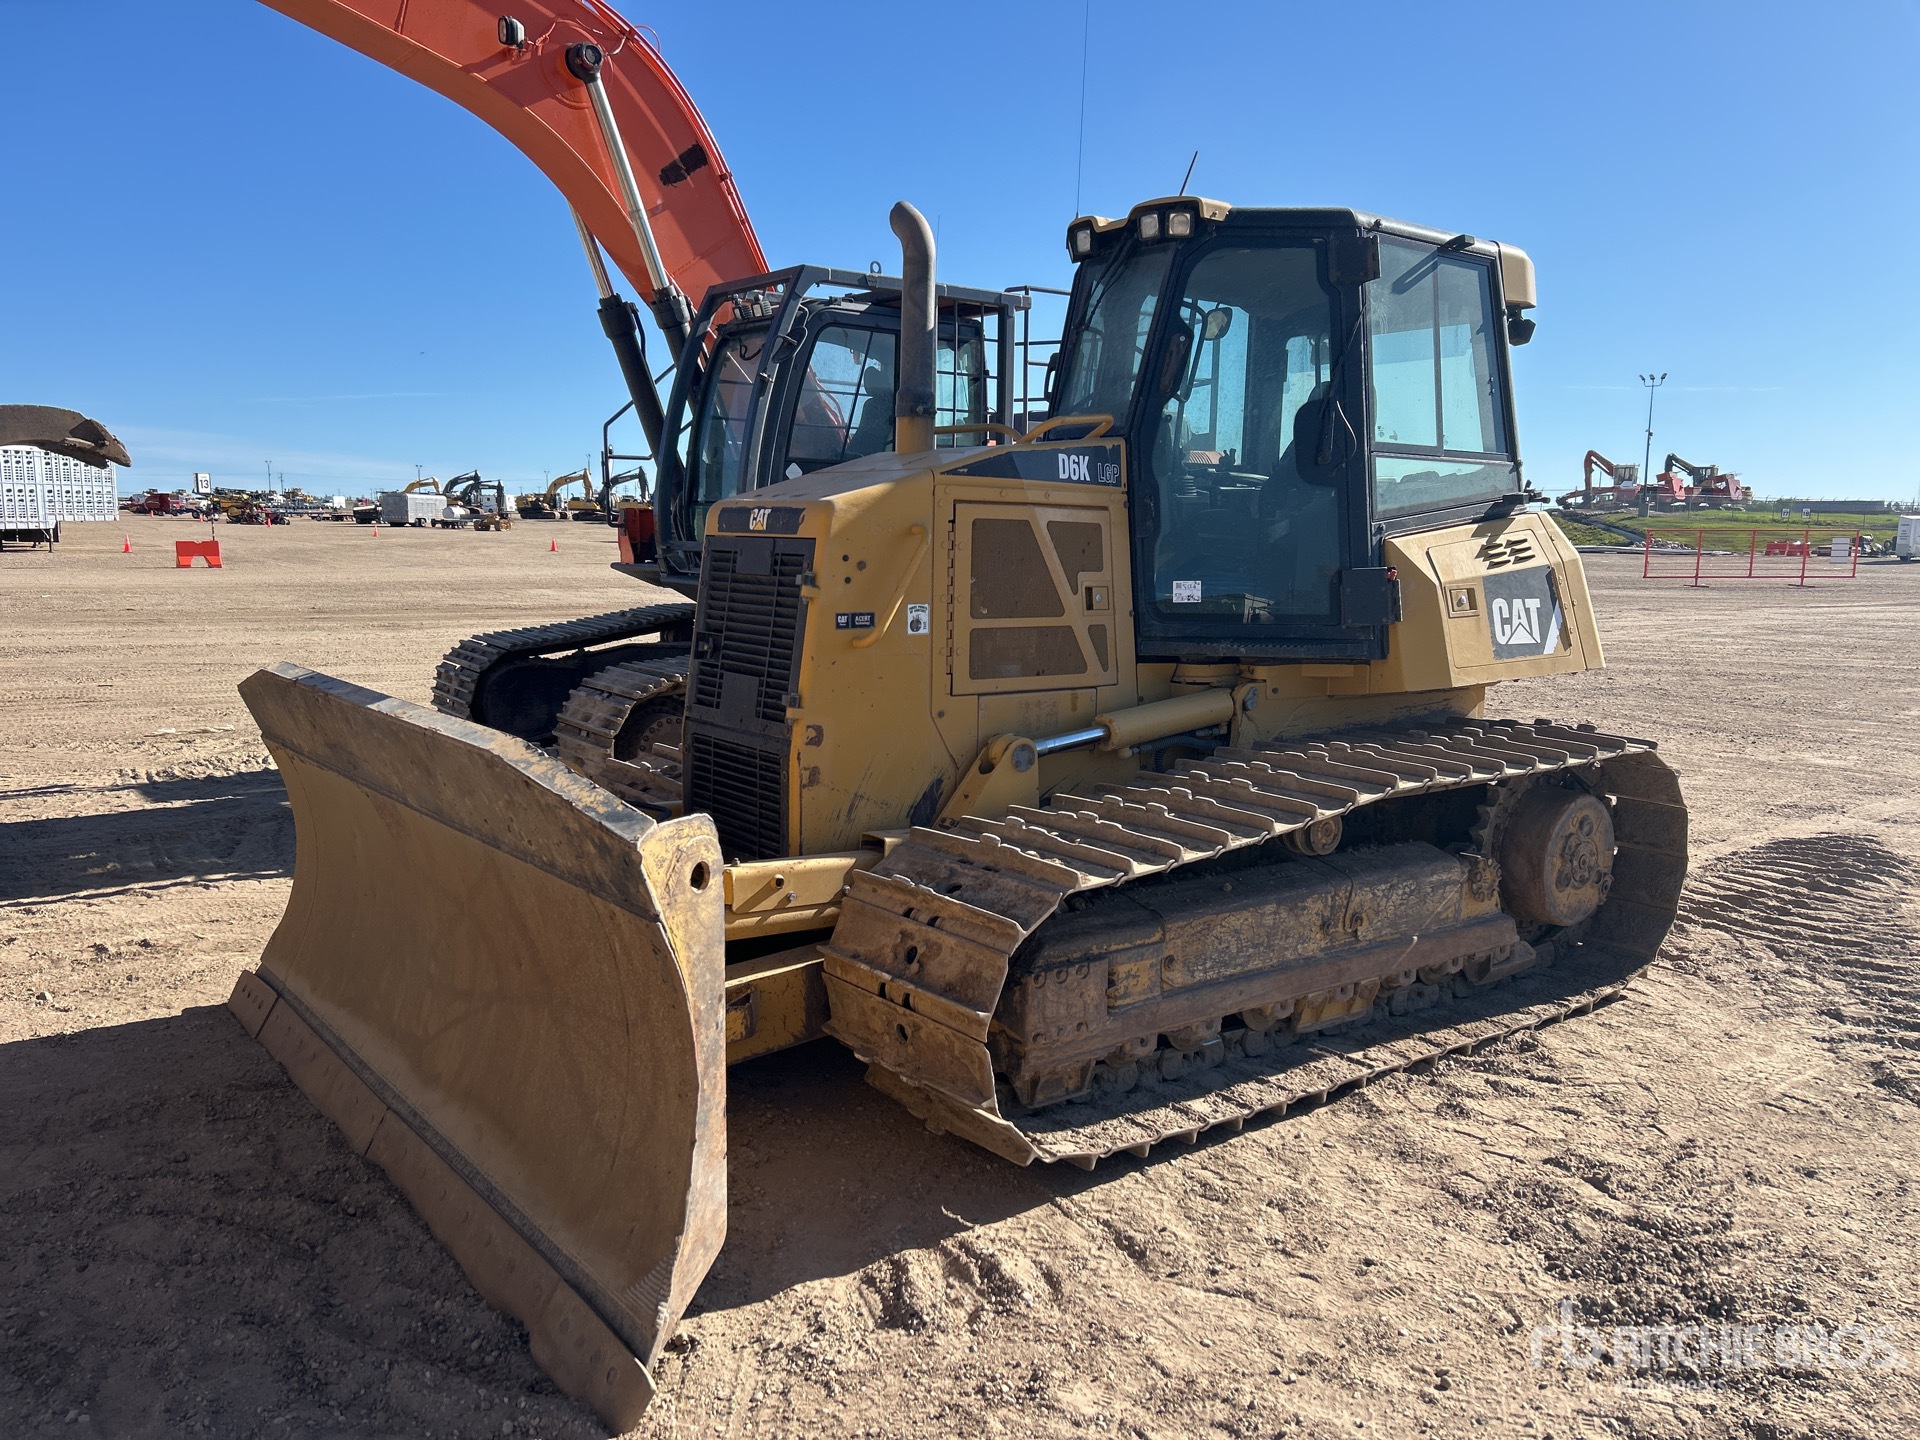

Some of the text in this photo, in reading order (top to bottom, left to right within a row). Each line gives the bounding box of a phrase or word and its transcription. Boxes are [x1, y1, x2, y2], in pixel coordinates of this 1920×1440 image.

[1058, 453, 1119, 483] D6K LGP
[199, 479, 210, 489] 13
[749, 508, 772, 531] CAT
[838, 615, 848, 623] CAT
[1492, 597, 1541, 645] CAT
